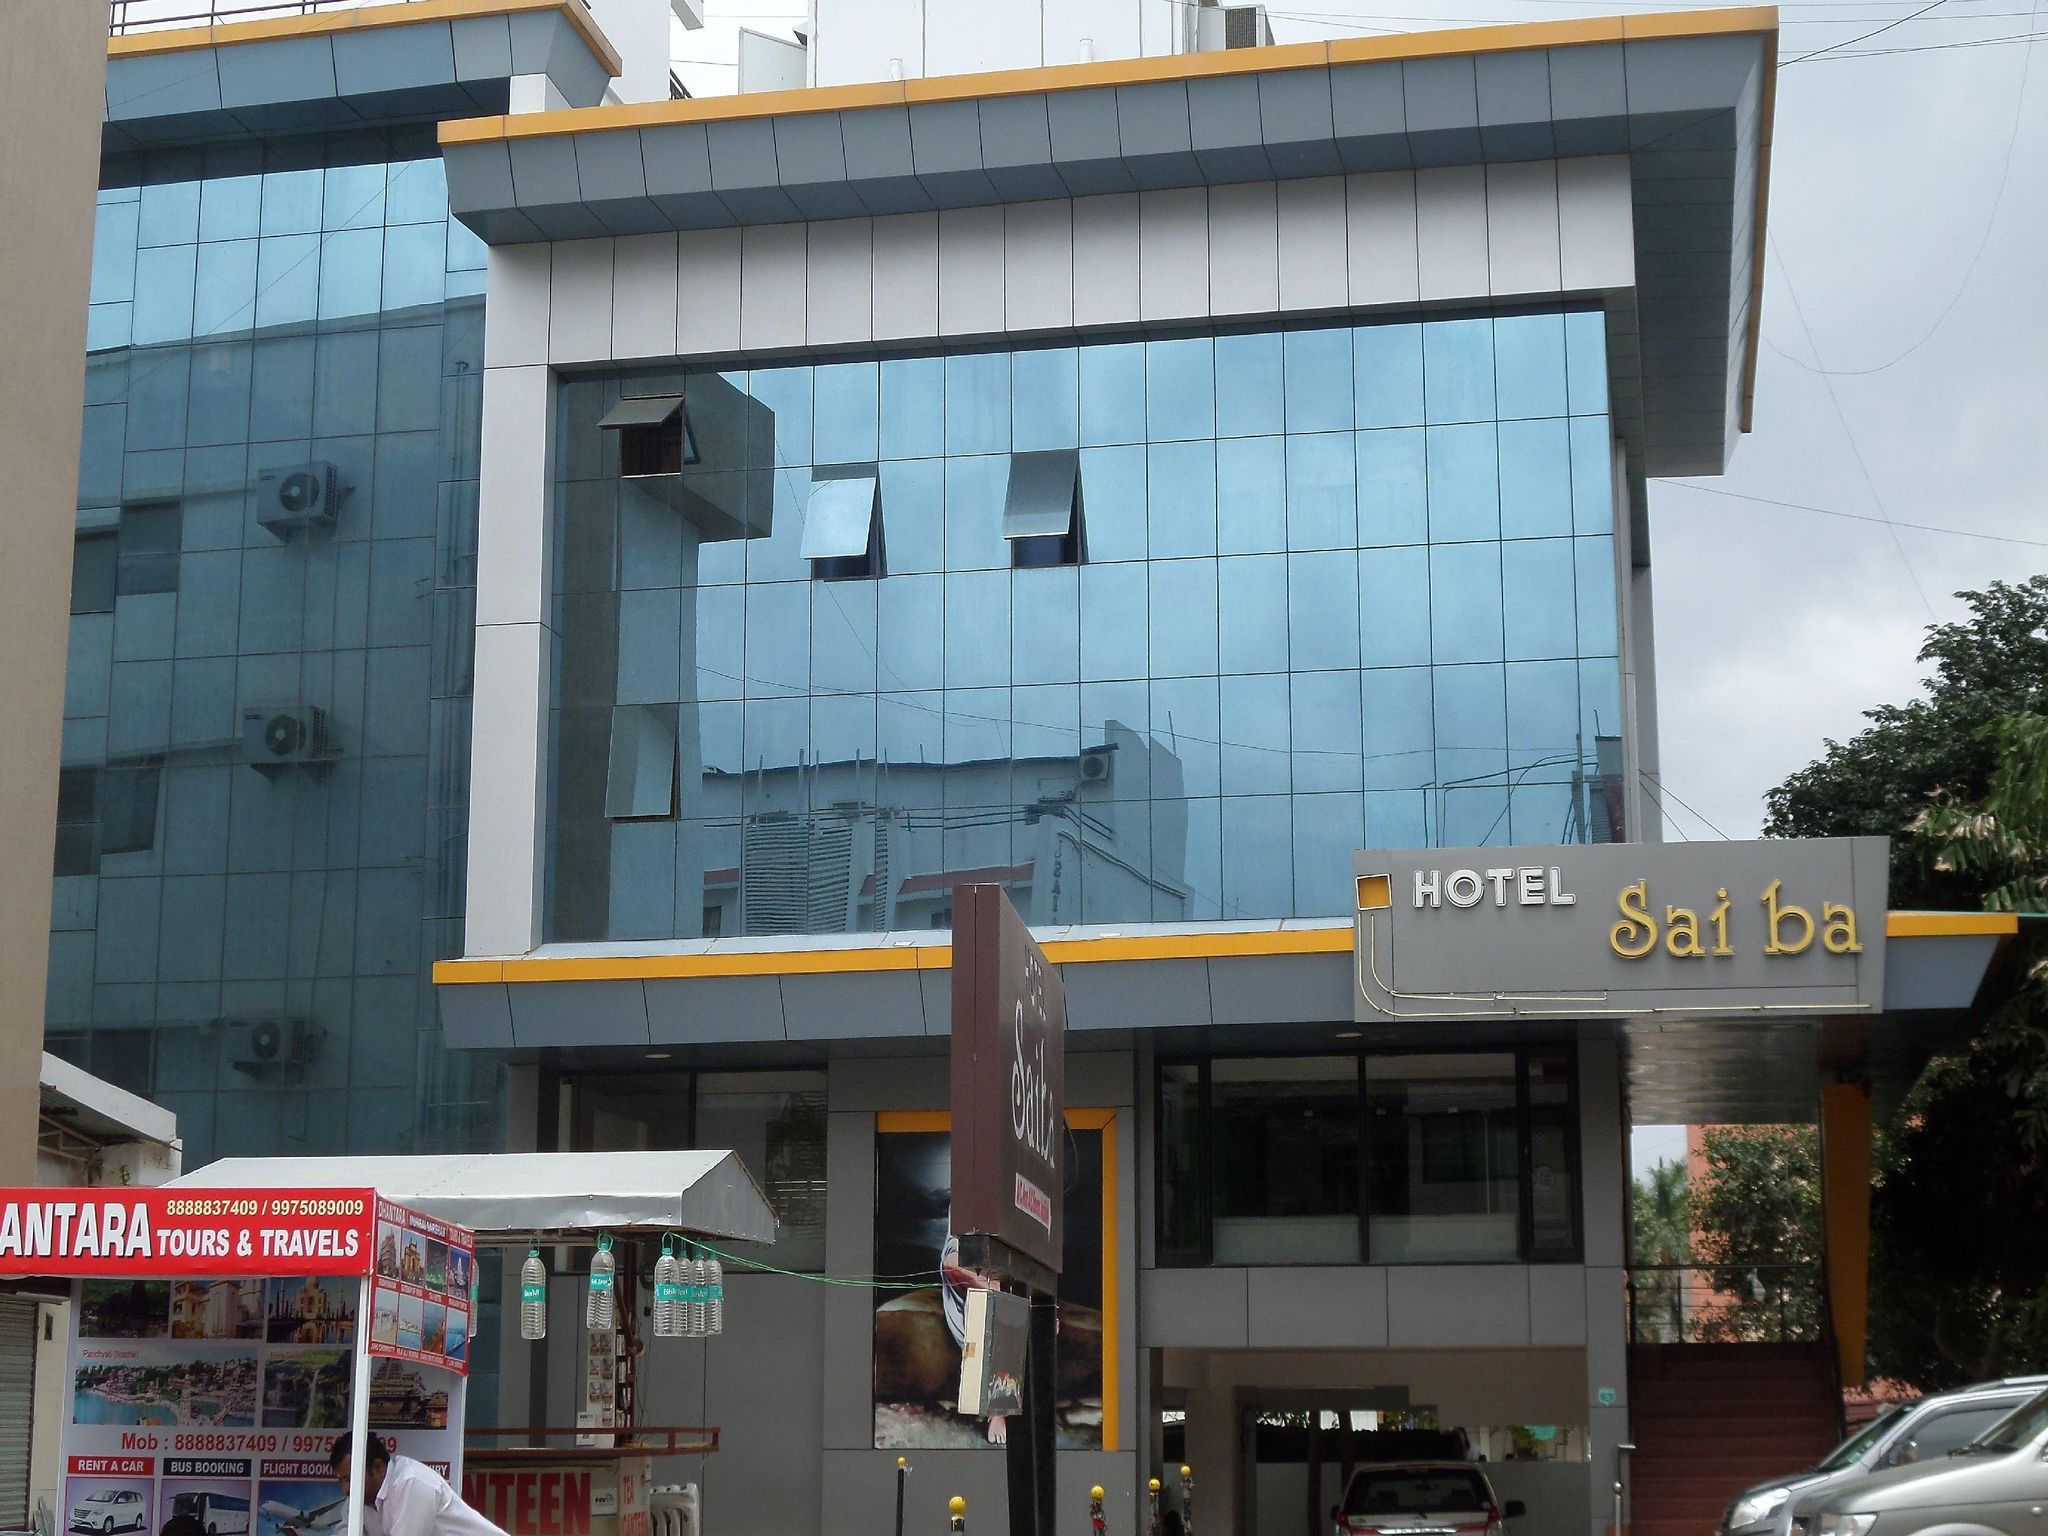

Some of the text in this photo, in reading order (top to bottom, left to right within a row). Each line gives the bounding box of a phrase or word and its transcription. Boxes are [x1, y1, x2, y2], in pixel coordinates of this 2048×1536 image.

[1413, 866, 1576, 908] HOTEL
[166, 1199, 258, 1217] 8888837409
[271, 1199, 364, 1217] 9975089009
[157, 1229, 359, 1257] TOURS & TRAVELS
[121, 1432, 158, 1450] Mob
[174, 1433, 277, 1452] 8888837409
[78, 1460, 145, 1472] RENT A CAR
[170, 1461, 245, 1474] BUS BOOKING
[263, 1463, 298, 1474] FLIGHT
